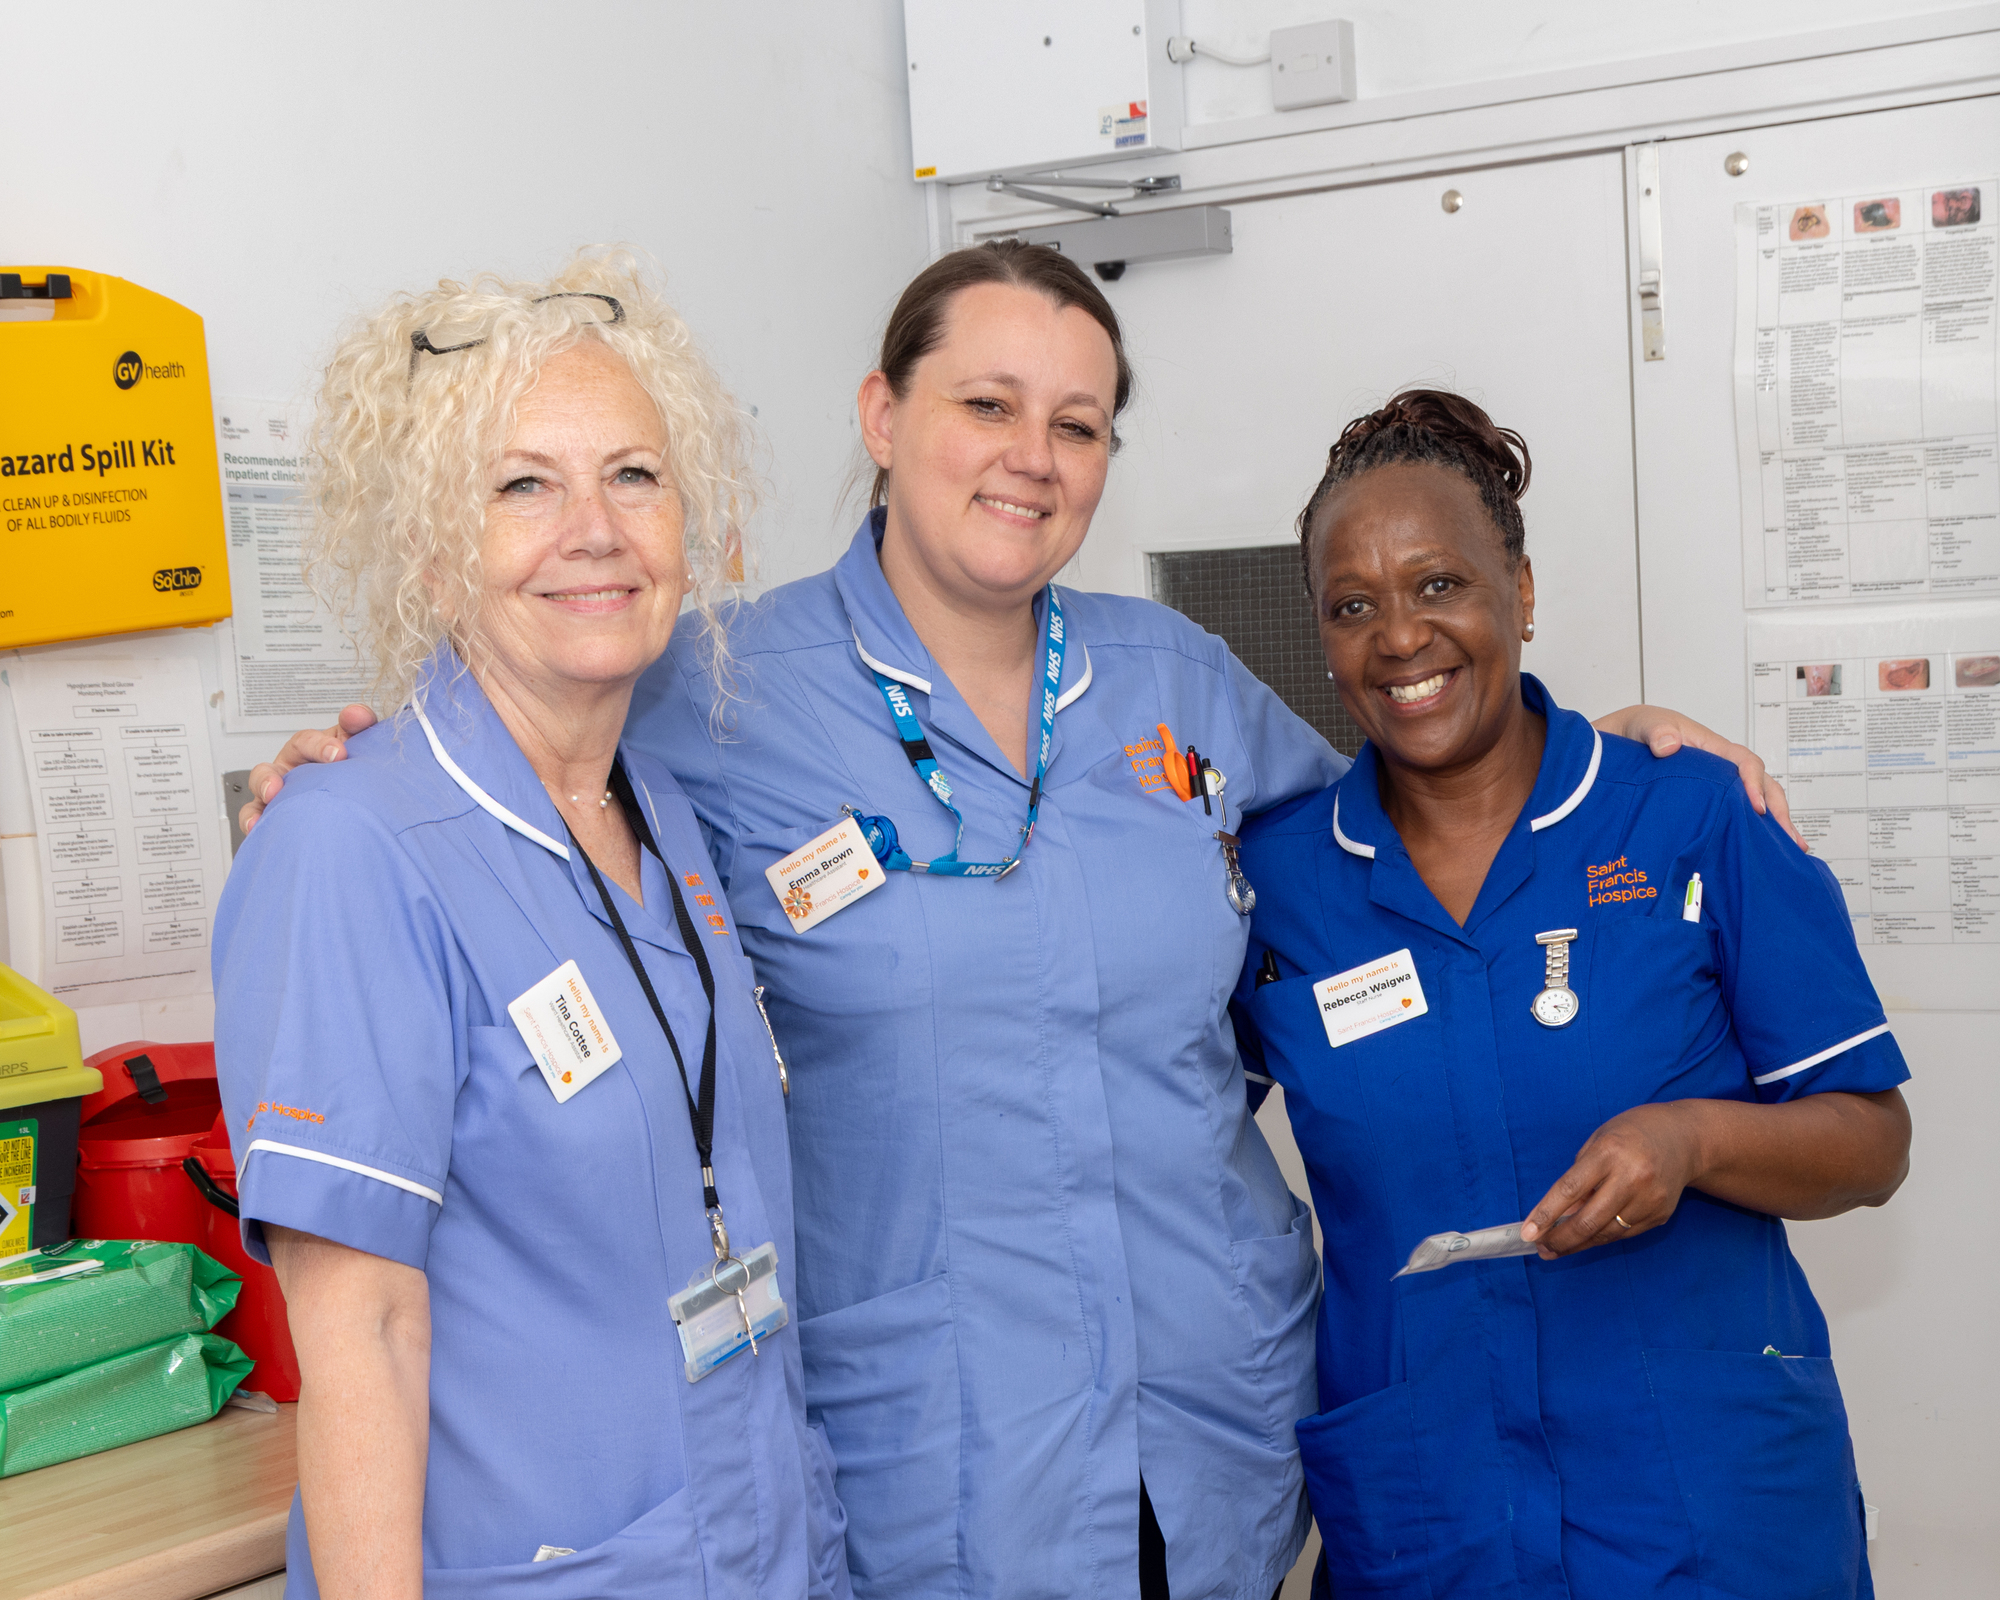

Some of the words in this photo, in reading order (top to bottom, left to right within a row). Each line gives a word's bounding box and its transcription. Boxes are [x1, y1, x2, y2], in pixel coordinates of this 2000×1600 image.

[116, 362, 142, 381] GV
[145, 361, 186, 379] health
[0, 444, 75, 477] azard
[81, 440, 136, 477] Spill
[141, 438, 176, 468] Kit
[224, 452, 298, 468] Recommended
[225, 467, 270, 482] inpatient
[3, 496, 41, 512] CLEAN
[44, 495, 60, 509] UP
[62, 494, 71, 507] &
[73, 488, 148, 506] DISINFECTION
[7, 518, 23, 532] OF
[26, 516, 47, 531] ALL
[49, 512, 91, 528] BODILY
[93, 508, 131, 525] FLUIDS
[1049, 611, 1064, 645] NHS
[1046, 648, 1061, 685] NHS
[885, 684, 913, 718] NHS
[1042, 688, 1056, 726] NHS
[1039, 728, 1050, 768] NHS
[1124, 737, 1164, 757] Saint
[1131, 755, 1164, 773] Fran
[866, 826, 882, 848] NH
[779, 861, 801, 877] Hello
[802, 852, 815, 864] my
[816, 837, 839, 855] name
[838, 831, 848, 840] is
[788, 866, 821, 890] Emma
[820, 847, 854, 872] Brown
[803, 873, 827, 890] Healthcare
[826, 862, 848, 876] Assistant
[964, 865, 1005, 876] NHS
[1587, 855, 1628, 878] Saint
[1588, 868, 1648, 893] Francis
[815, 894, 837, 909] Francis
[836, 879, 861, 896] Hospice
[840, 892, 852, 901] Caring
[1589, 886, 1658, 907] Hospice
[1326, 981, 1349, 993] Hello
[1351, 975, 1364, 984] my
[1366, 966, 1389, 978] name
[1391, 961, 1399, 969] is
[1323, 989, 1368, 1012] Rebecca
[1369, 973, 1412, 994] Waigwa
[1356, 997, 1368, 1006] Staff
[1368, 993, 1383, 1001] Nurse
[555, 994, 571, 1021] Tina
[568, 1021, 591, 1059] Cottee
[566, 977, 583, 1003] Hello
[580, 1003, 591, 1018] my
[587, 1018, 604, 1044] name
[601, 1043, 609, 1054] is
[1337, 1024, 1353, 1035] Saint
[1353, 1016, 1377, 1029] Francis
[1377, 1006, 1403, 1020] Hospice
[523, 1007, 536, 1026] Saint
[533, 1024, 549, 1050] Francis
[546, 1047, 563, 1076] Hospice
[548, 1000, 559, 1016] Ward
[556, 1015, 572, 1041] Healthcare
[570, 1041, 584, 1064] Assistant
[0, 1062, 29, 1075] RPS
[272, 1101, 325, 1124] Hospice
[3, 1140, 10, 1152] DO
[11, 1139, 20, 1151] NOT
[21, 1138, 31, 1149] FILL
[11, 1150, 19, 1161] THE
[20, 1148, 31, 1160] LINE
[3, 1163, 31, 1177] INCINERATED
